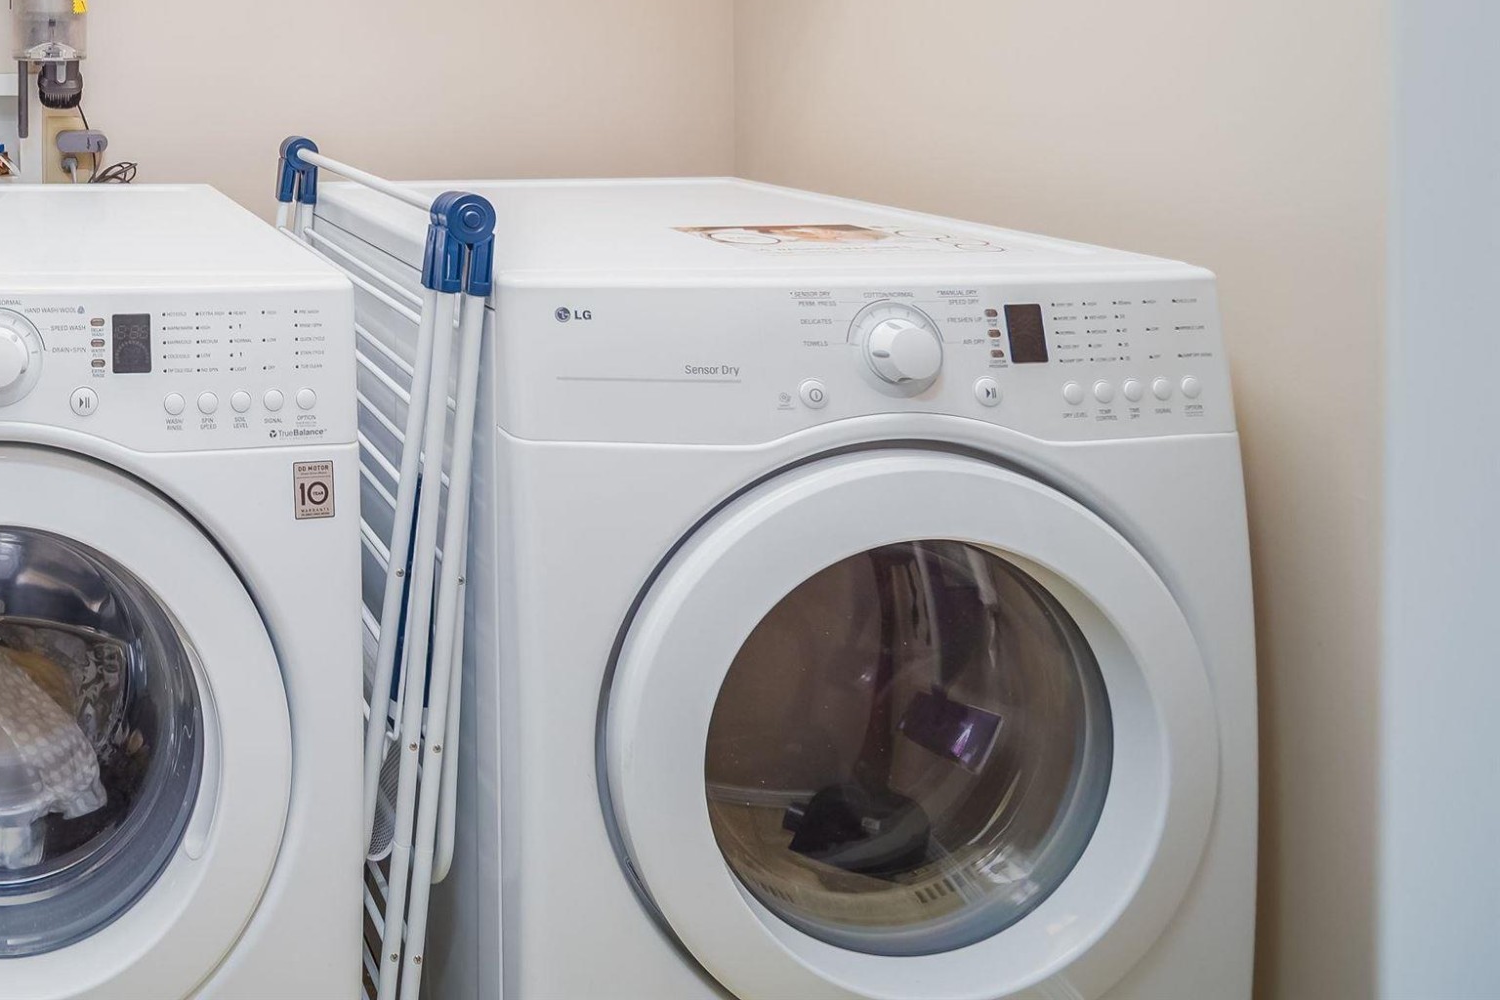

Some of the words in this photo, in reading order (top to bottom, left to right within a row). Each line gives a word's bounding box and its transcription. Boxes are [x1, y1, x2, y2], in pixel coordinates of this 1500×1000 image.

[574, 310, 592, 320] LG
[684, 364, 719, 375] Sensor
[721, 365, 740, 377] Dry
[299, 481, 329, 506] 10
